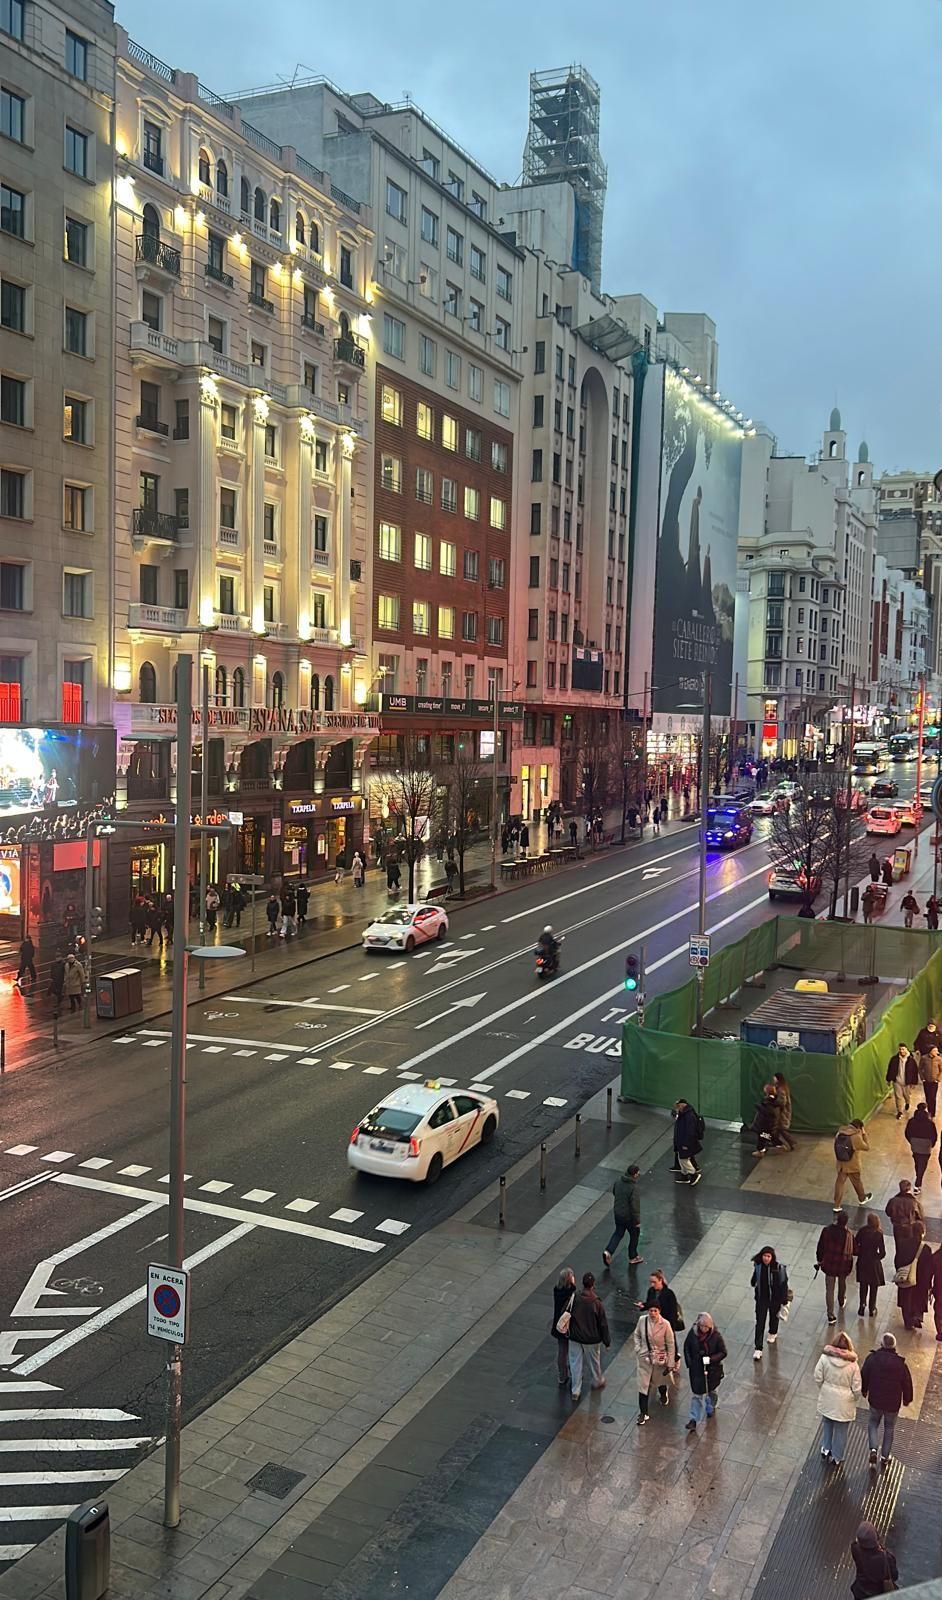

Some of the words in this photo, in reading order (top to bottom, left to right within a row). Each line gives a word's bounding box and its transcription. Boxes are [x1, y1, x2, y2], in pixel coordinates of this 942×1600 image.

[673, 638, 692, 661] SIETE
[389, 696, 407, 707] UMB
[218, 710, 239, 725] VIDA
[291, 803, 316, 814] TXAPELA
[332, 801, 355, 810] TXAPELA
[150, 1272, 160, 1280] EN
[162, 1274, 184, 1286] ACERA
[153, 1316, 167, 1325] TODO
[168, 1320, 180, 1328] TIPO
